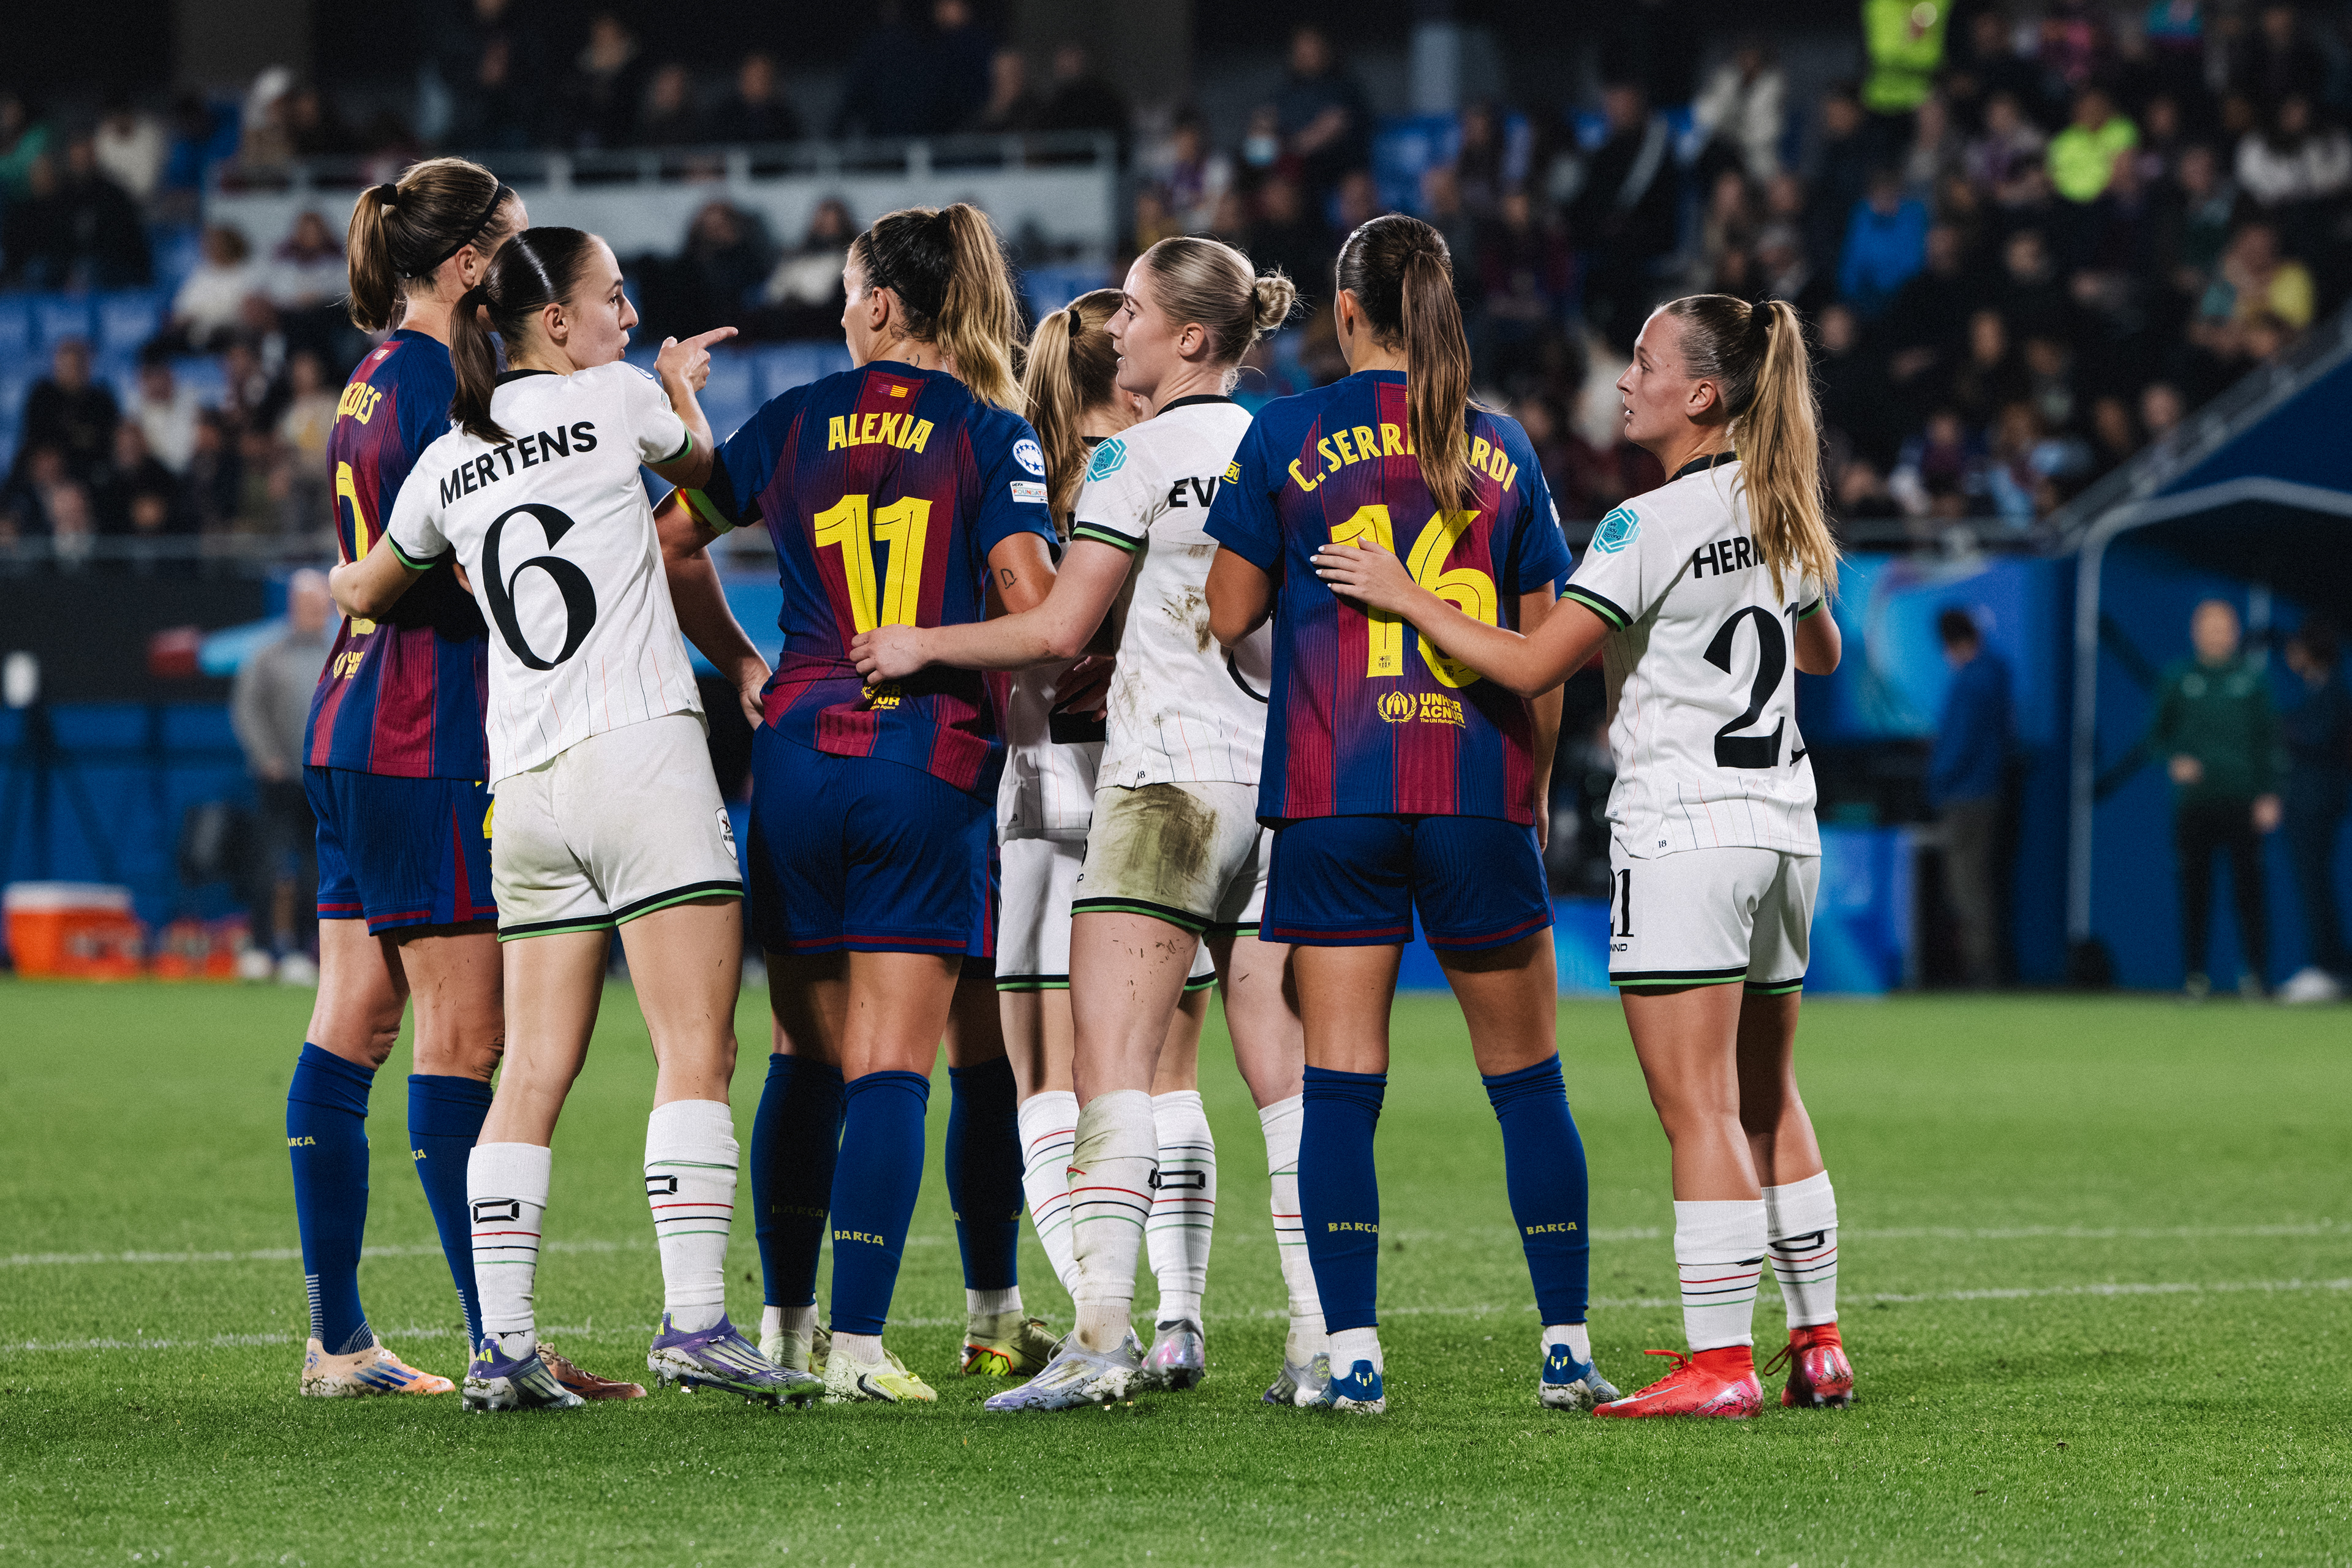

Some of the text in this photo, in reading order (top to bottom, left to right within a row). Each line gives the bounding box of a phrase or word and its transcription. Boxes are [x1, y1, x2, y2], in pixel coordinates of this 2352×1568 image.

[828, 412, 934, 453] ALEXIA
[439, 421, 597, 509] MERTENS
[1169, 476, 1224, 507] EV
[814, 494, 933, 635] 11
[482, 503, 597, 671] 6
[1330, 503, 1498, 688] 16
[1419, 705, 1465, 724] ACNUR
[1420, 693, 1463, 712] UNHCR
[1658, 840, 1667, 848] 18
[834, 1231, 884, 1246] BARÇA
[1328, 1222, 1379, 1234] BARÇA
[1526, 1222, 1578, 1235] BARÇA
